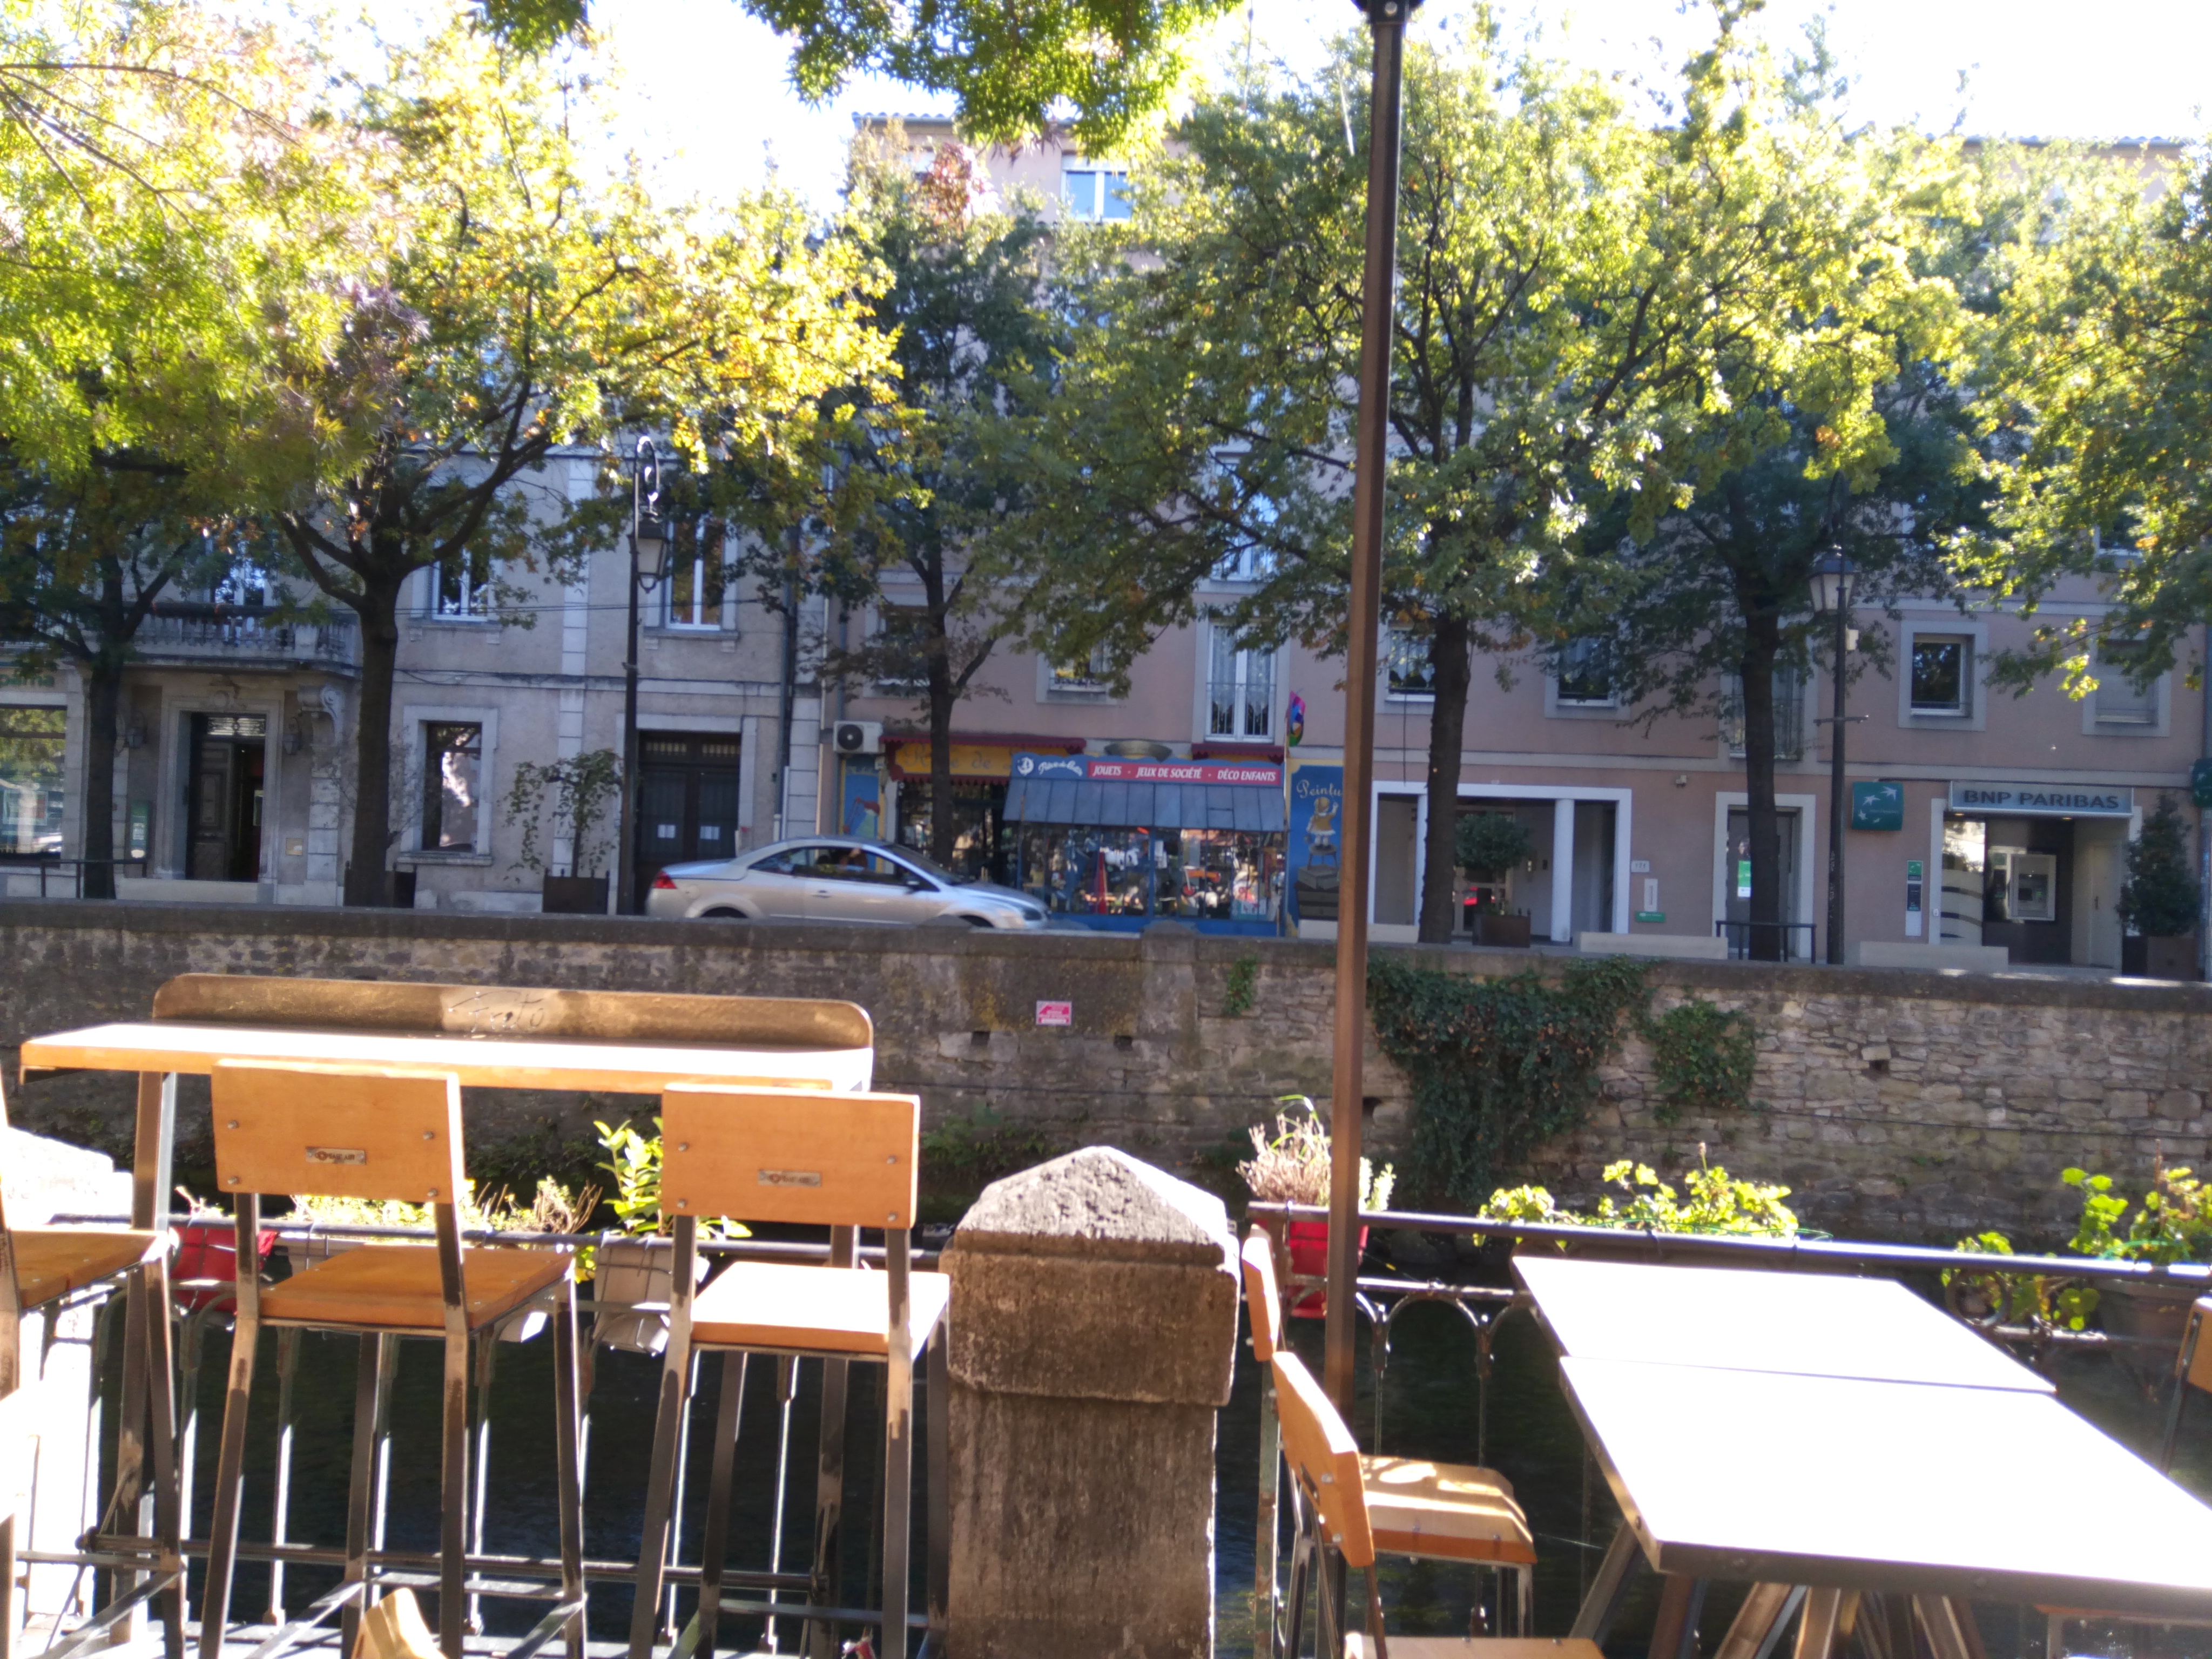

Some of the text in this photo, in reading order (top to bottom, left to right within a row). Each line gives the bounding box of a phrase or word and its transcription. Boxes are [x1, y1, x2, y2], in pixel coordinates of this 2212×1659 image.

[1092, 765, 1122, 777] JOUETS
[1136, 766, 1203, 779] JEUX DE SOCIÉTÉ
[1217, 768, 1277, 782] DÉCO ENFANTS
[1964, 790, 2119, 808] BNP PARIBAS
